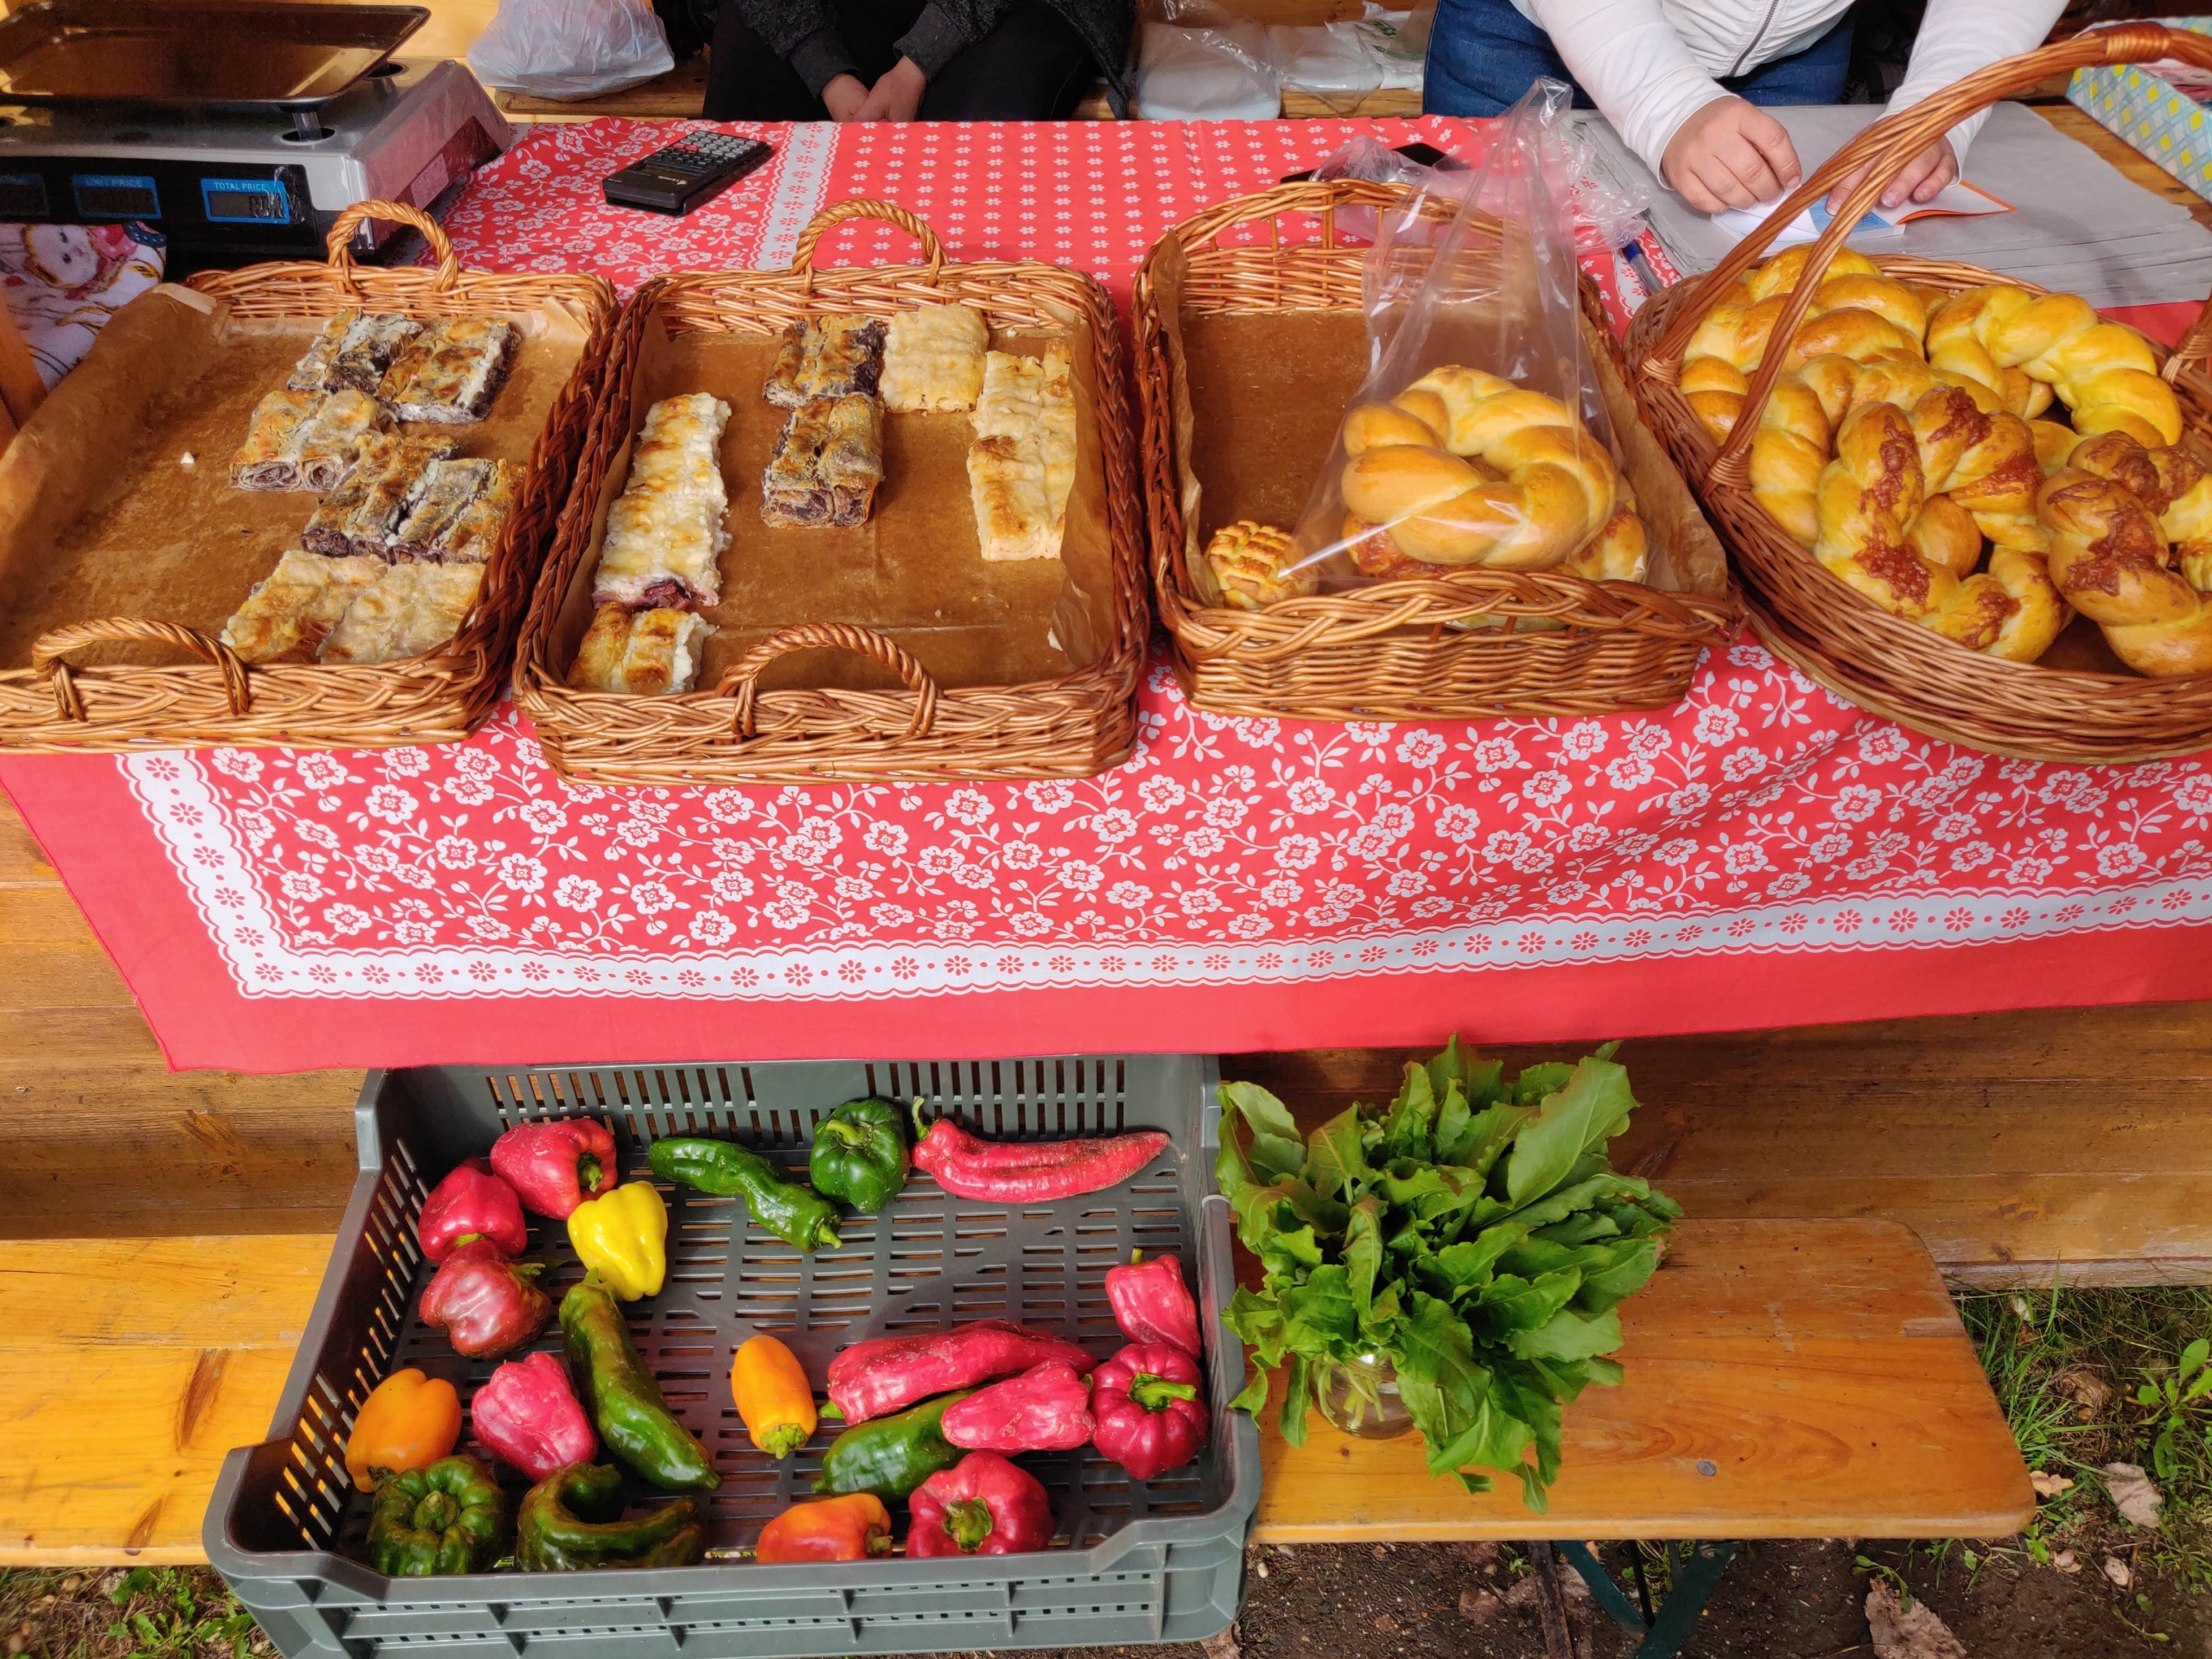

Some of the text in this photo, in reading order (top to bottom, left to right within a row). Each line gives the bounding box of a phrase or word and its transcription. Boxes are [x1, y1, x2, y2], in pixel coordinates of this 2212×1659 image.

[111, 178, 143, 188] PRICE
[213, 181, 267, 191] TOTAL PRICE
